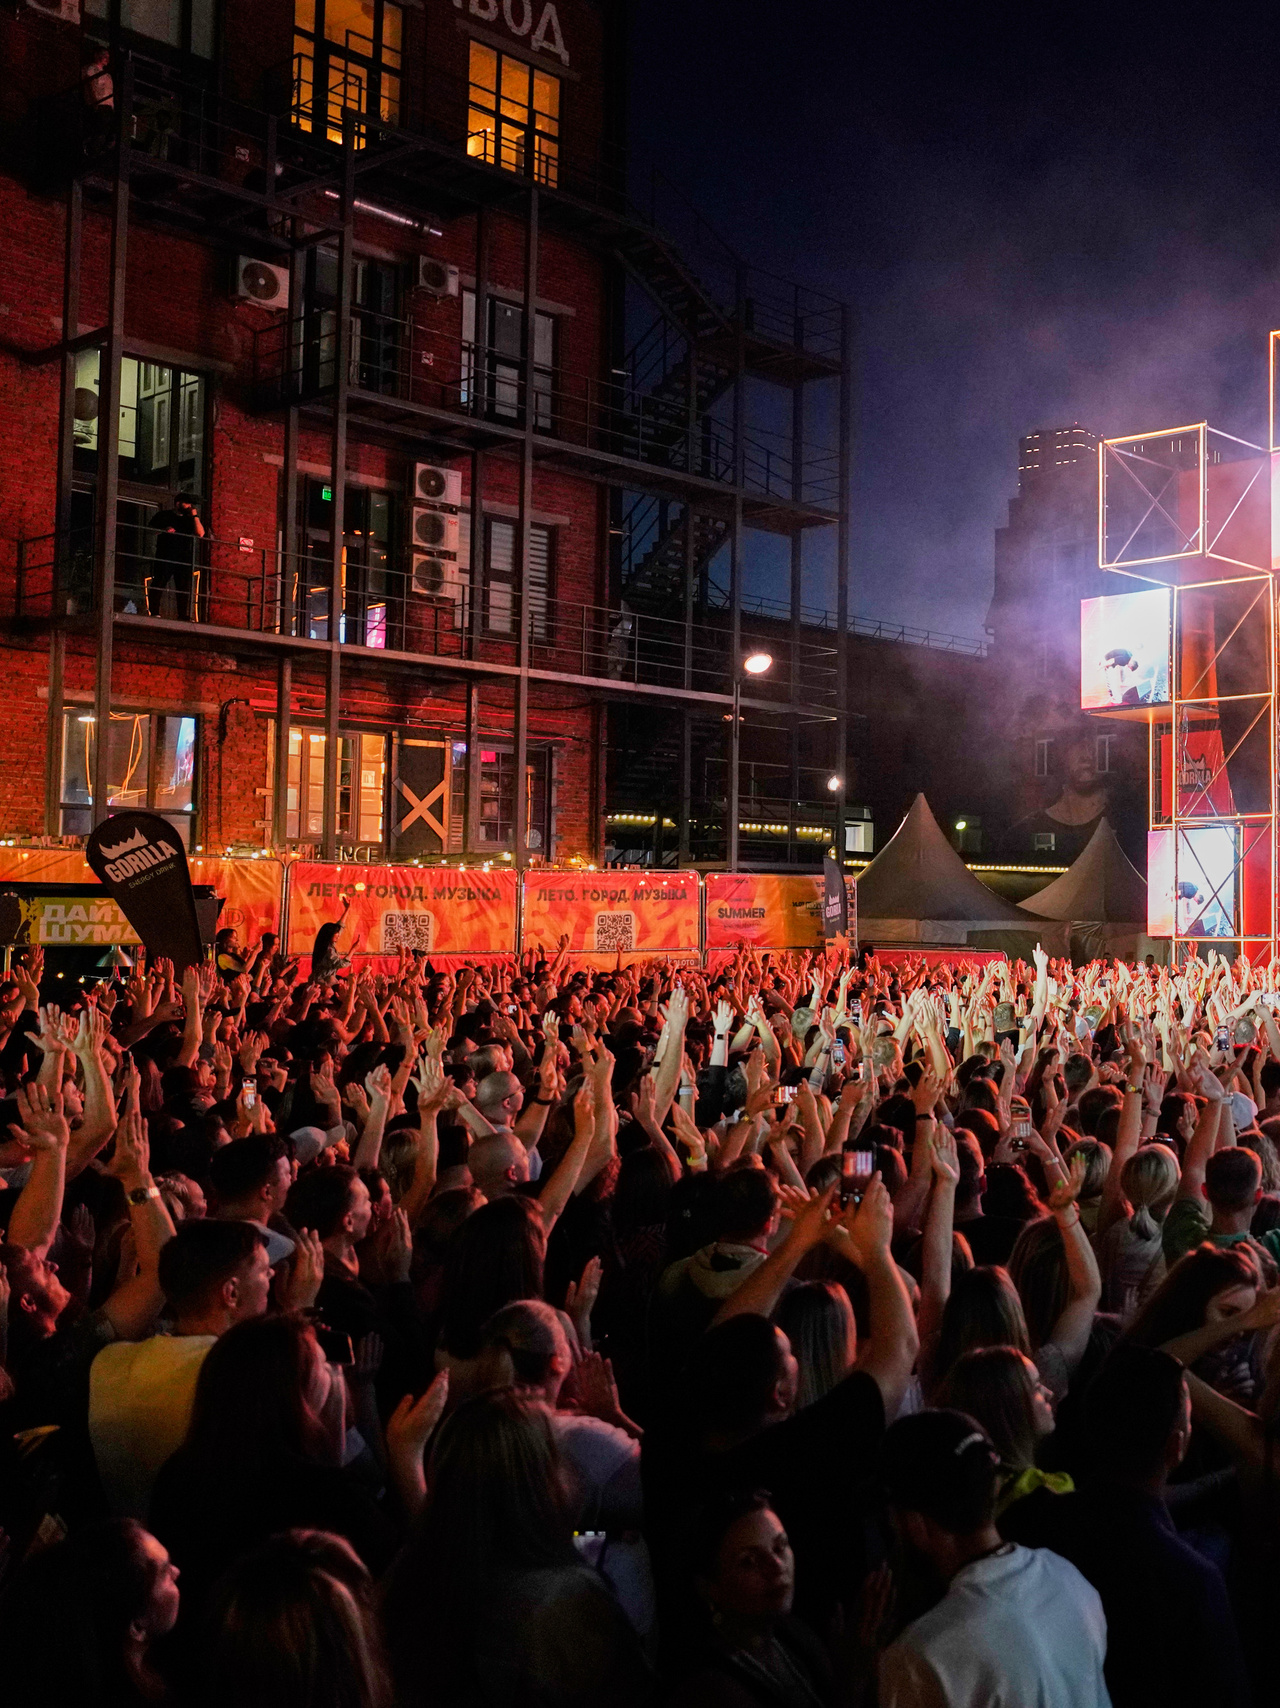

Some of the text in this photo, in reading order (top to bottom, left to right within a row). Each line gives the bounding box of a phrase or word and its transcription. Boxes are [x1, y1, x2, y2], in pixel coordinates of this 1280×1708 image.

[104, 839, 179, 884] GORILLA
[128, 862, 176, 889] ENERGY DRINK
[365, 885, 428, 902] ГОРОД.
[433, 886, 502, 901] МУЗЫКА
[537, 888, 688, 903] ЛЕТО. ГОРОД. МУЗЫКА
[717, 907, 765, 919] SUMMER
